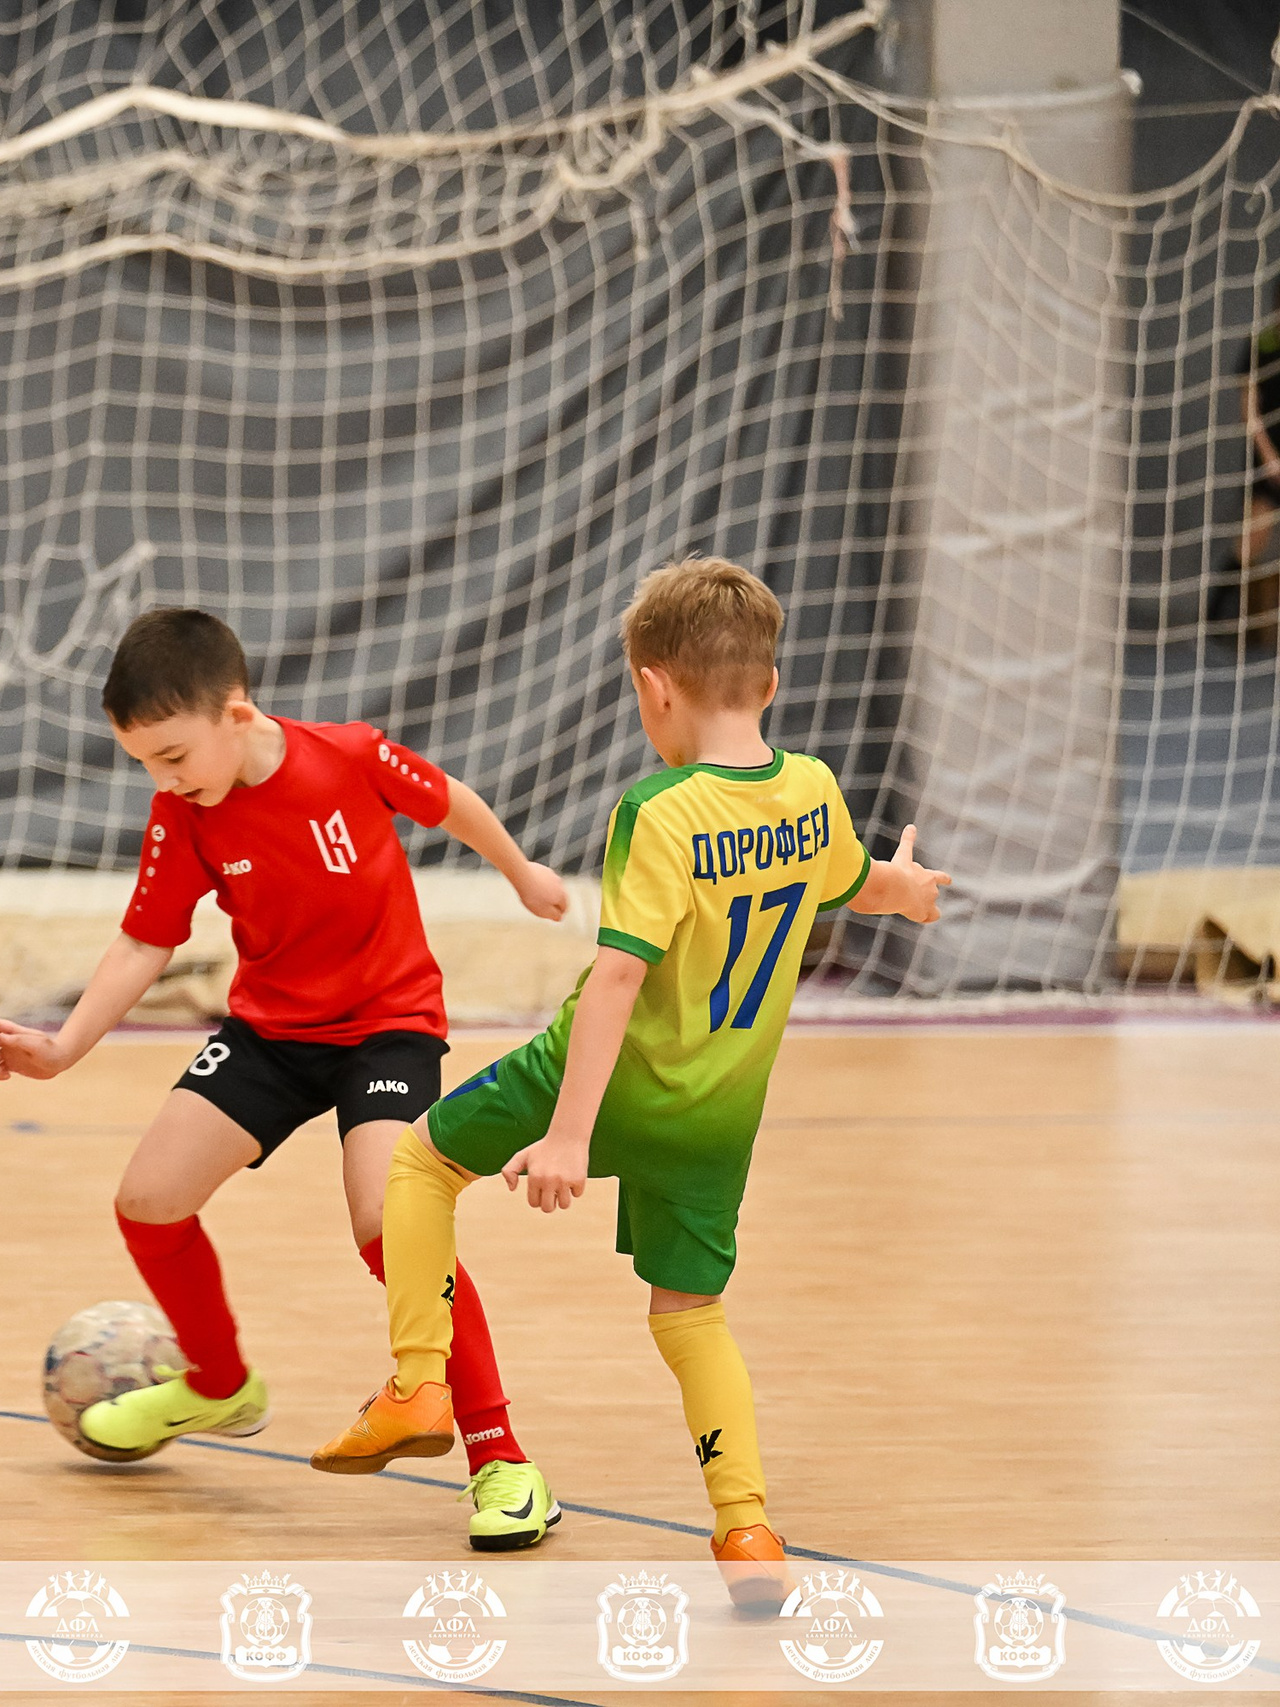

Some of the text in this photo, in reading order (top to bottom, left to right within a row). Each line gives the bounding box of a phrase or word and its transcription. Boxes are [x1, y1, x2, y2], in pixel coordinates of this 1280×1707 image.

[222, 859, 253, 876] JKO
[709, 882, 807, 1034] 17
[366, 1080, 409, 1095] JAKO
[464, 1426, 505, 1446] Joma
